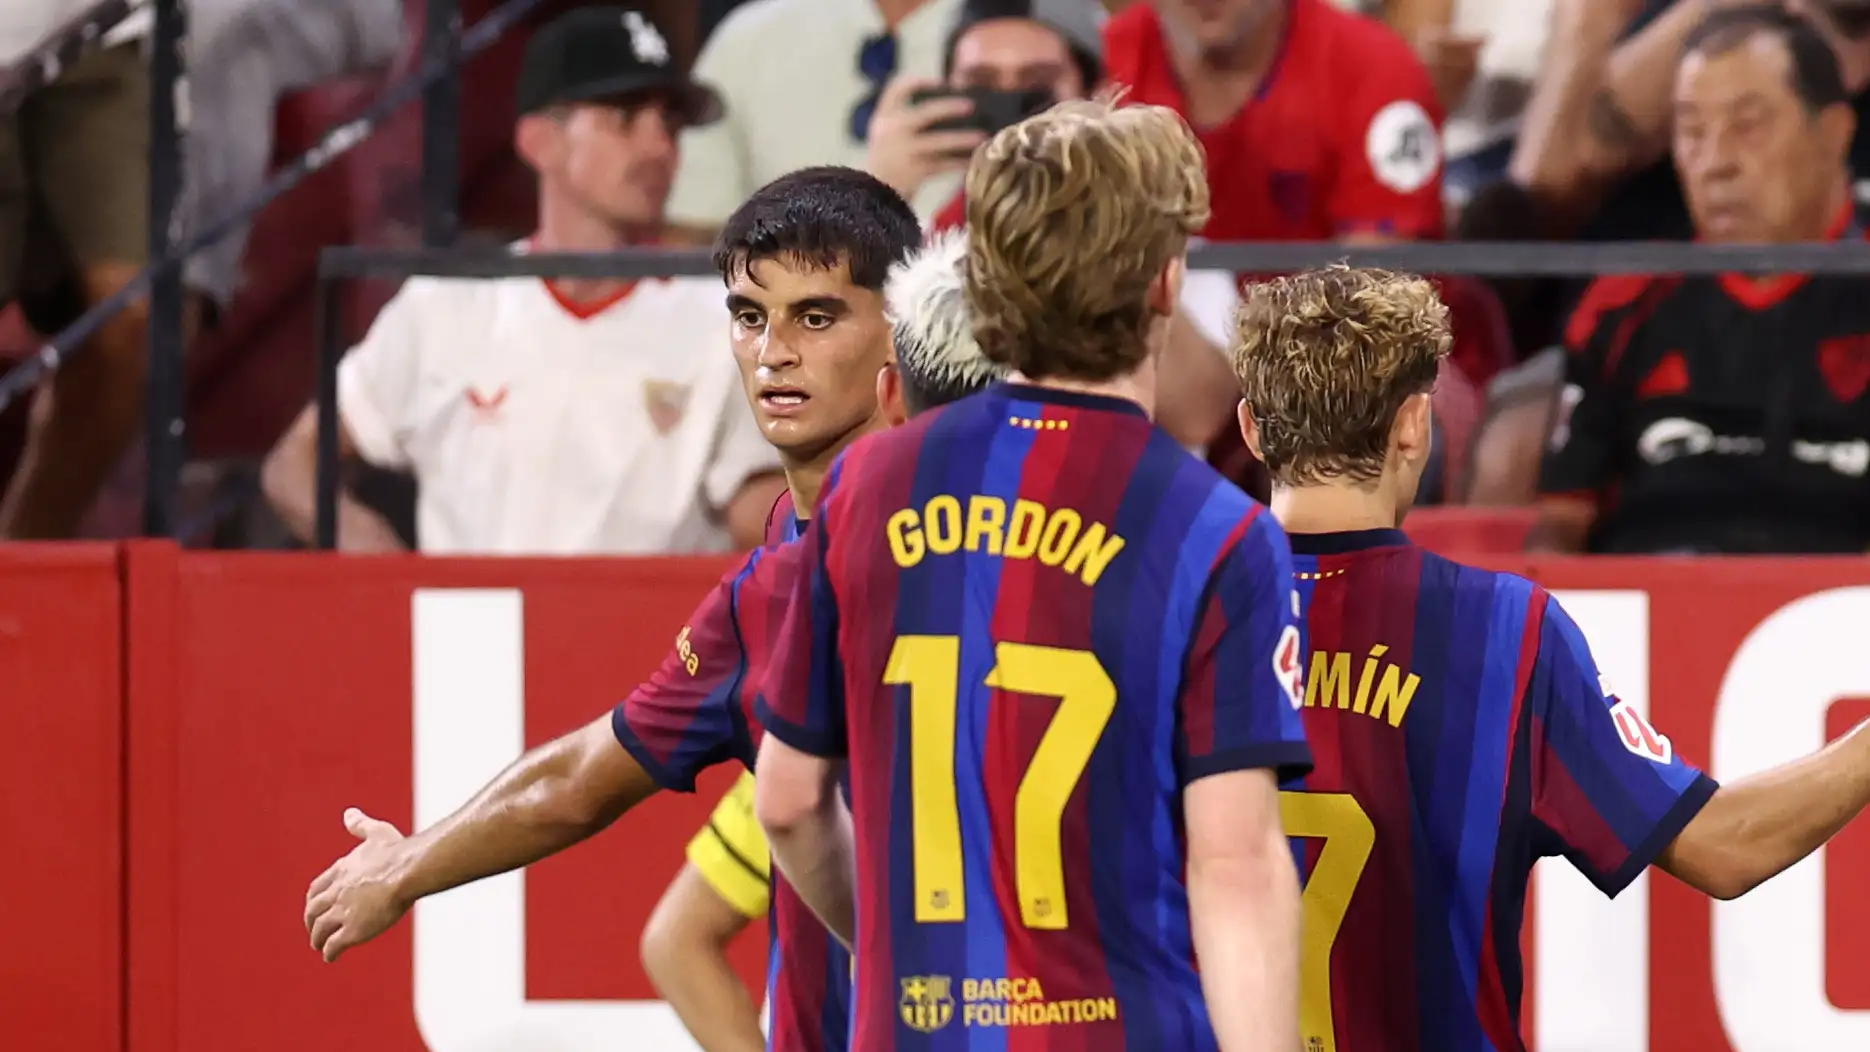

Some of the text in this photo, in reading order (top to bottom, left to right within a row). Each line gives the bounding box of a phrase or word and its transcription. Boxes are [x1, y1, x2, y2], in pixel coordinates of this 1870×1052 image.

[886, 494, 1126, 587] GORDON
[676, 625, 699, 677] dea
[1304, 643, 1421, 728] MÍN
[883, 635, 1117, 929] 17
[962, 977, 1043, 1005] BARÇA
[963, 997, 1117, 1027] FOUNDATION
